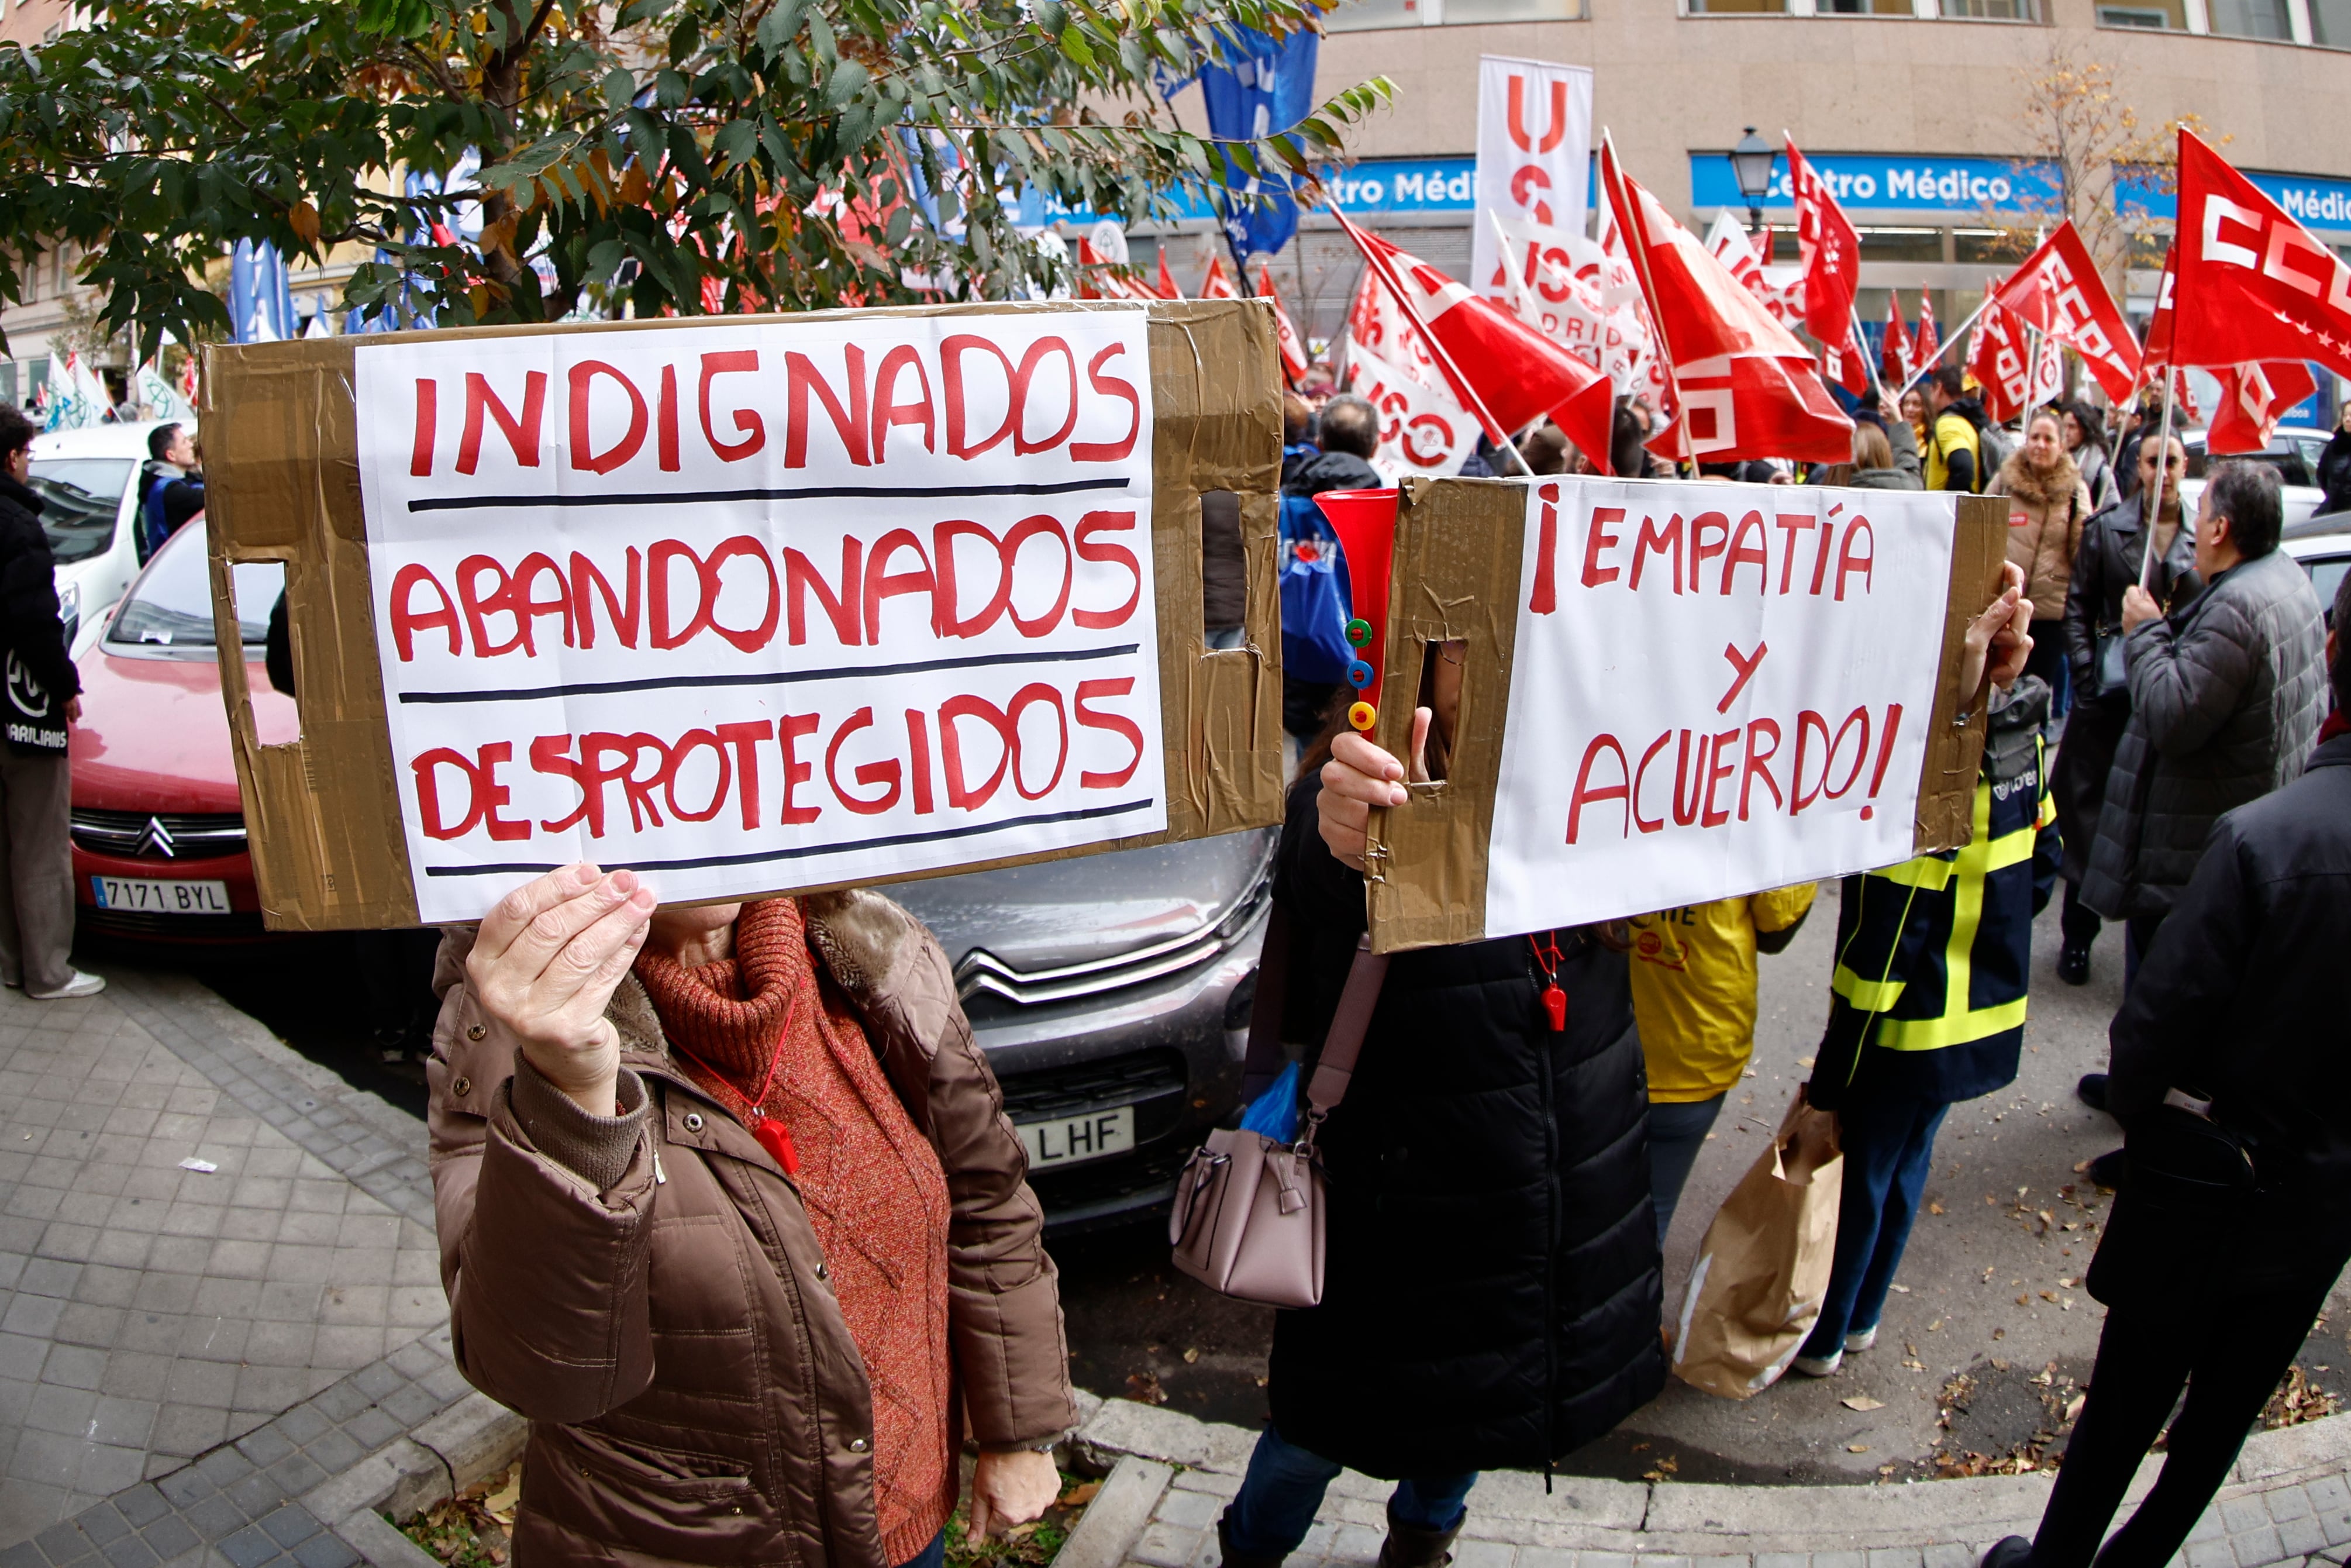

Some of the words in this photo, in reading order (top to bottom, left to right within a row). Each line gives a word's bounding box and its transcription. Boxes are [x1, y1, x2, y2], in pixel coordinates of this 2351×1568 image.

[1887, 167, 2011, 202] Médico
[411, 334, 1140, 477] INDIGNADOS
[390, 511, 1141, 662] ABANDONADOS
[1529, 483, 1874, 615] ¡EMPATÍA
[1716, 640, 1768, 714] Y
[411, 677, 1144, 842] DESPROTEGIDOS
[1566, 703, 1903, 845] ACUERDO!
[106, 881, 166, 909] 7171
[175, 884, 223, 910] BYL
[1039, 1115, 1119, 1161] LHF
